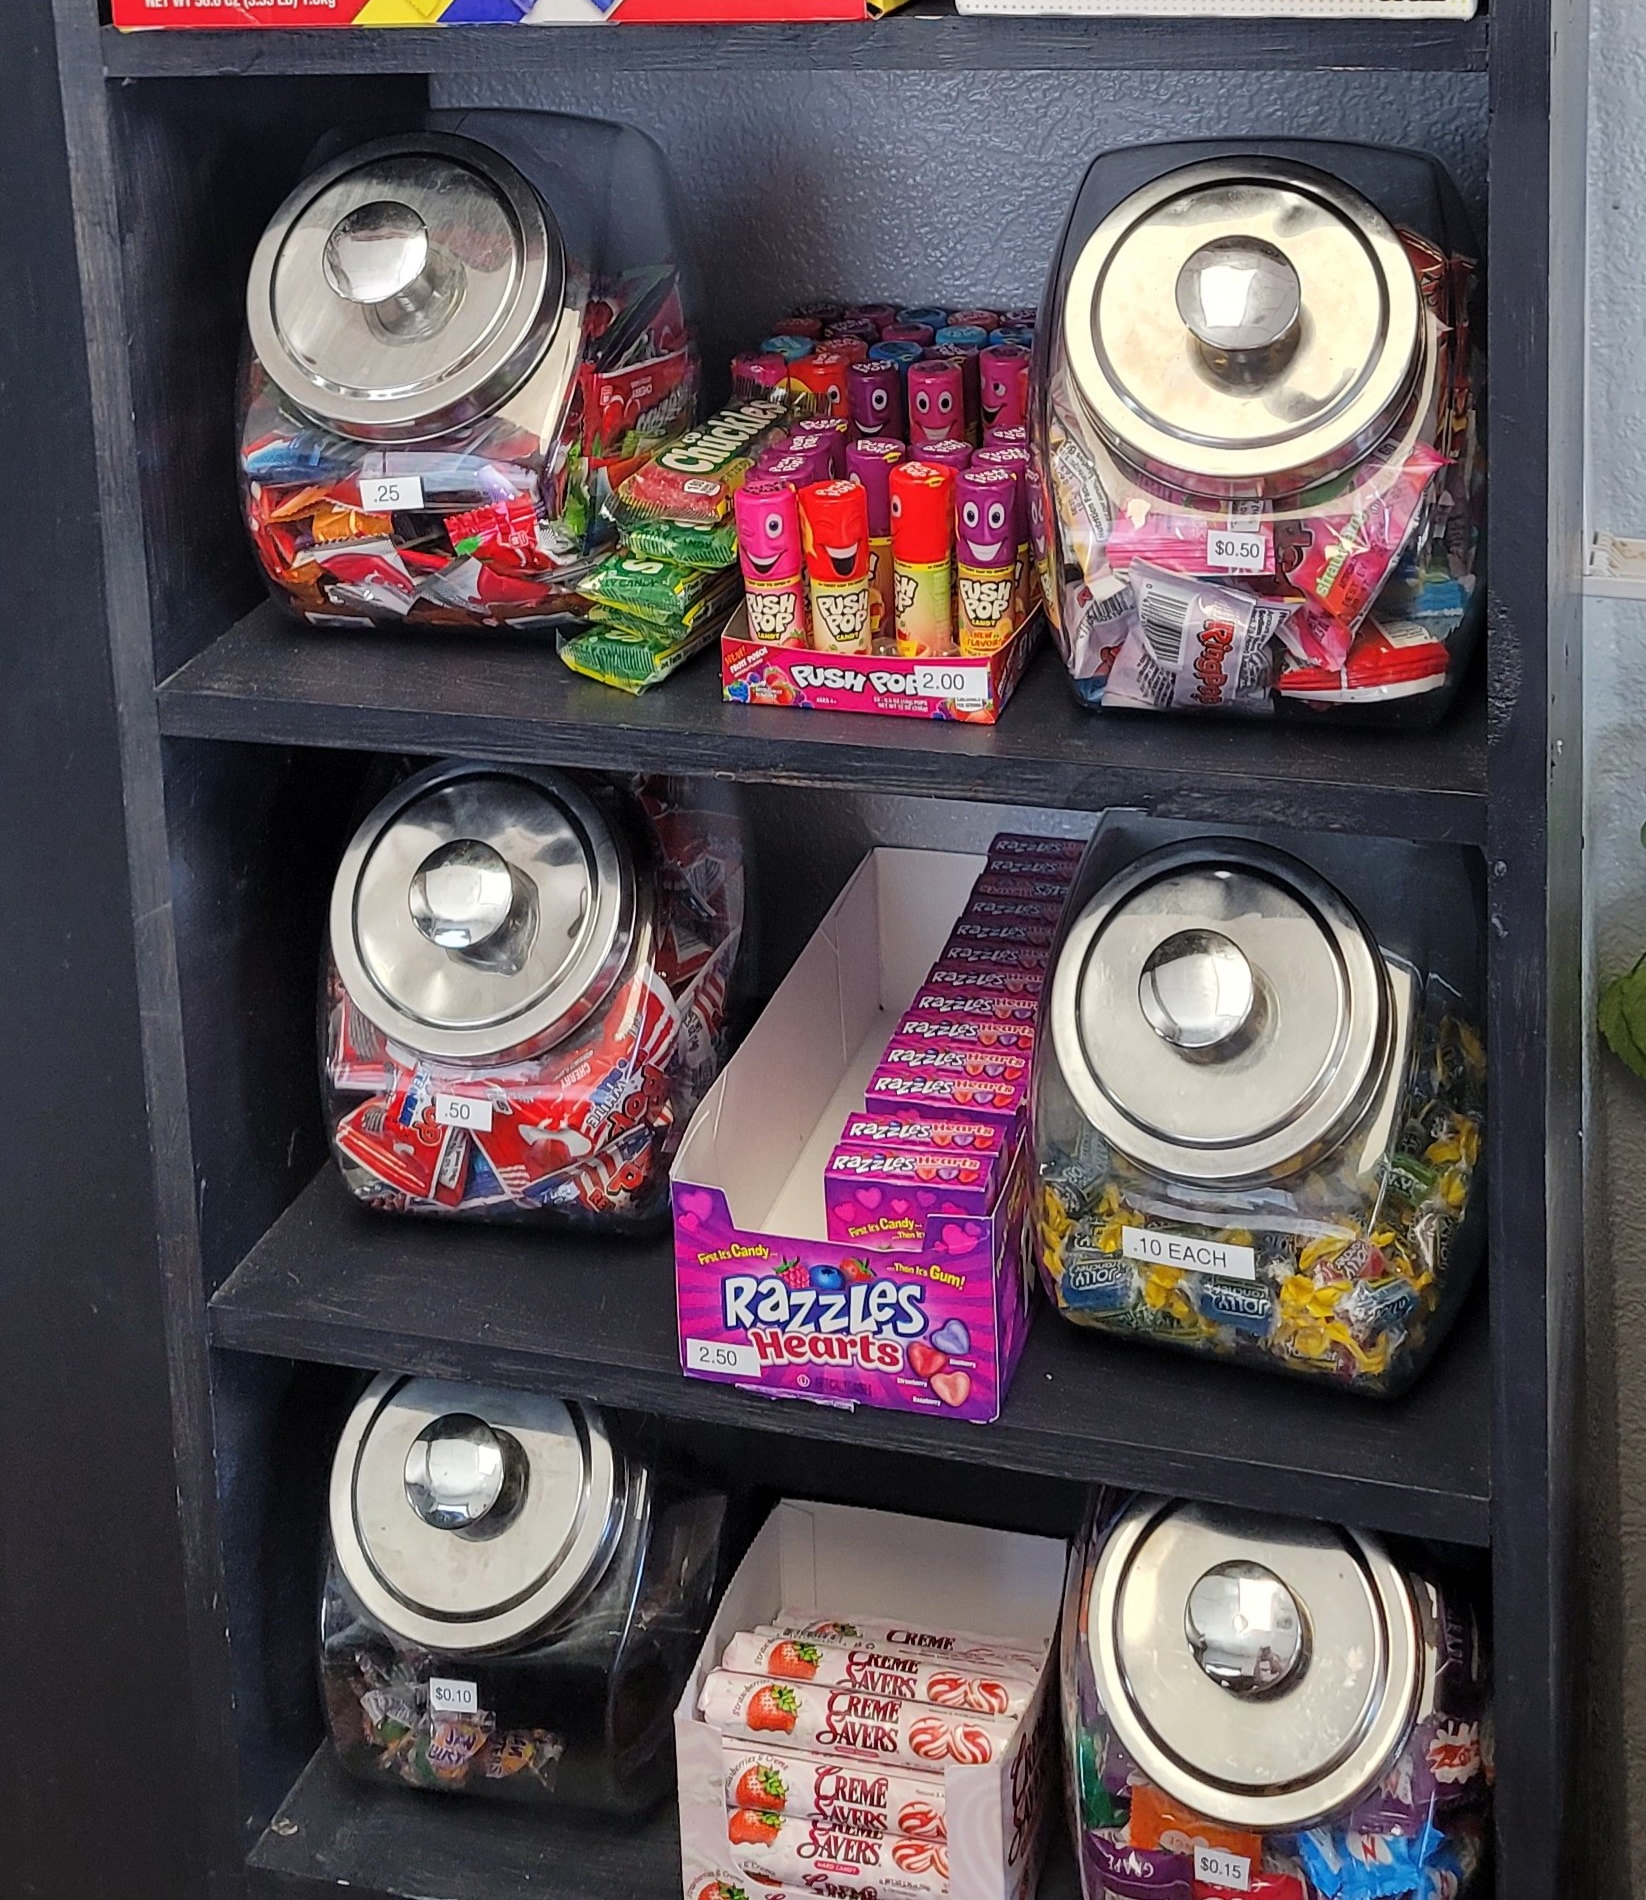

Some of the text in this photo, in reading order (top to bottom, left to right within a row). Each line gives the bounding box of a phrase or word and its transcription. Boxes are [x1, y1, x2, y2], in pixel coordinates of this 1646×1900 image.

[660, 399, 788, 474] Chuckles
[373, 485, 400, 503] .25
[1215, 541, 1260, 558] $0.50
[959, 579, 1012, 600] PUSH
[746, 592, 796, 614] PUSH
[817, 589, 869, 617] PUSH
[965, 599, 1009, 620] POP
[753, 611, 793, 632] POP
[827, 611, 867, 635] POP
[791, 664, 867, 693] PUSH
[922, 672, 965, 691] 2.00
[966, 1052, 1026, 1068] Hearts
[559, 1062, 592, 1090] CHERRY
[954, 1080, 1016, 1095] Hearts
[444, 1103, 470, 1120] .50
[931, 1122, 995, 1137] Hearts
[915, 1155, 981, 1170] Hearts
[848, 1226, 870, 1238] First
[697, 1250, 718, 1265] First
[1133, 1238, 1227, 1269] .10 EACH
[929, 1265, 967, 1291] Gum!
[1071, 1268, 1117, 1291] JOLLY
[1215, 1295, 1272, 1319] JOLLY
[700, 1346, 737, 1367] 2.50
[750, 1327, 904, 1372] Hearts
[848, 1650, 919, 1674] CREME
[435, 1686, 472, 1704] $0.10
[827, 1689, 902, 1725] CREME
[815, 1711, 899, 1753] SAVERS
[813, 1765, 889, 1809] CREME
[796, 1828, 882, 1867] SAVERS
[1200, 1856, 1242, 1877] $0.15
